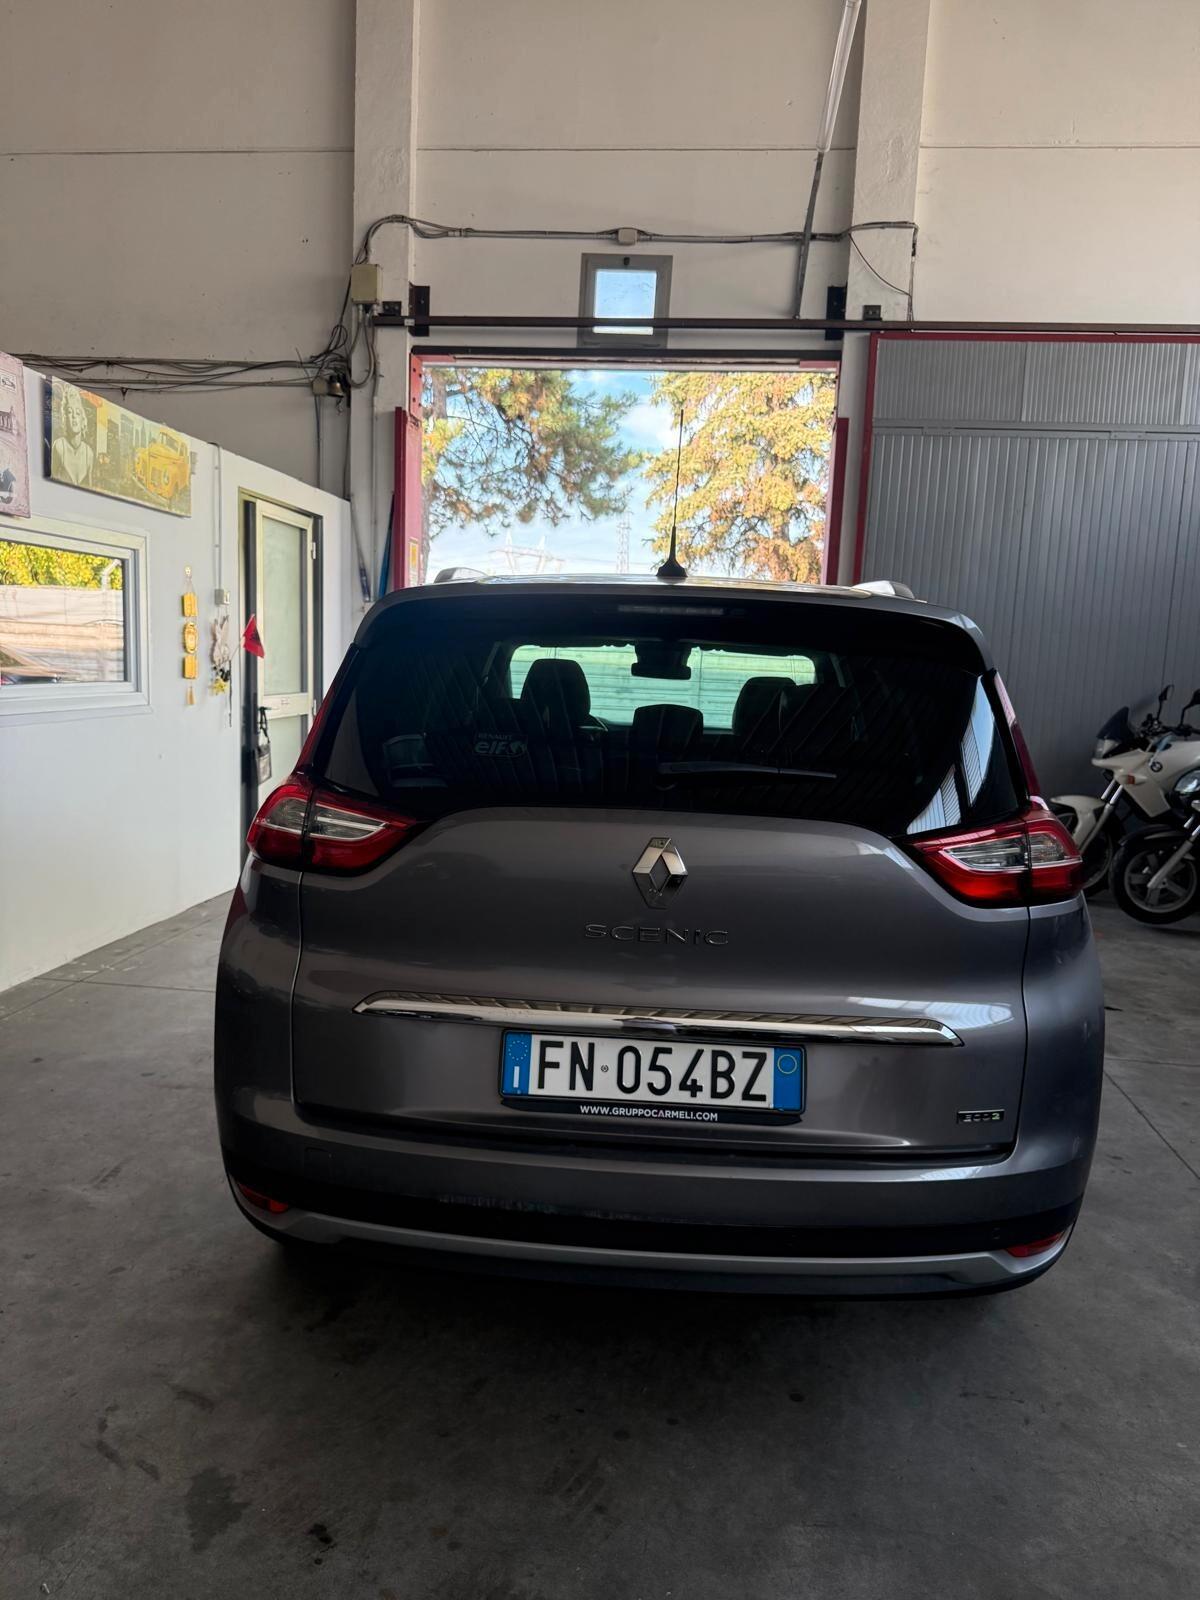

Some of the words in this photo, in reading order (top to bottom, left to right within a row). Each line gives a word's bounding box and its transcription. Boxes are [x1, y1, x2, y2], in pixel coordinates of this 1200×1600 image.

[585, 924, 729, 945] SCENIC
[538, 1040, 595, 1091] FN
[616, 1045, 768, 1102] 054BZ
[580, 1105, 719, 1121] WWW.GRUPPOCARMELI.COM
